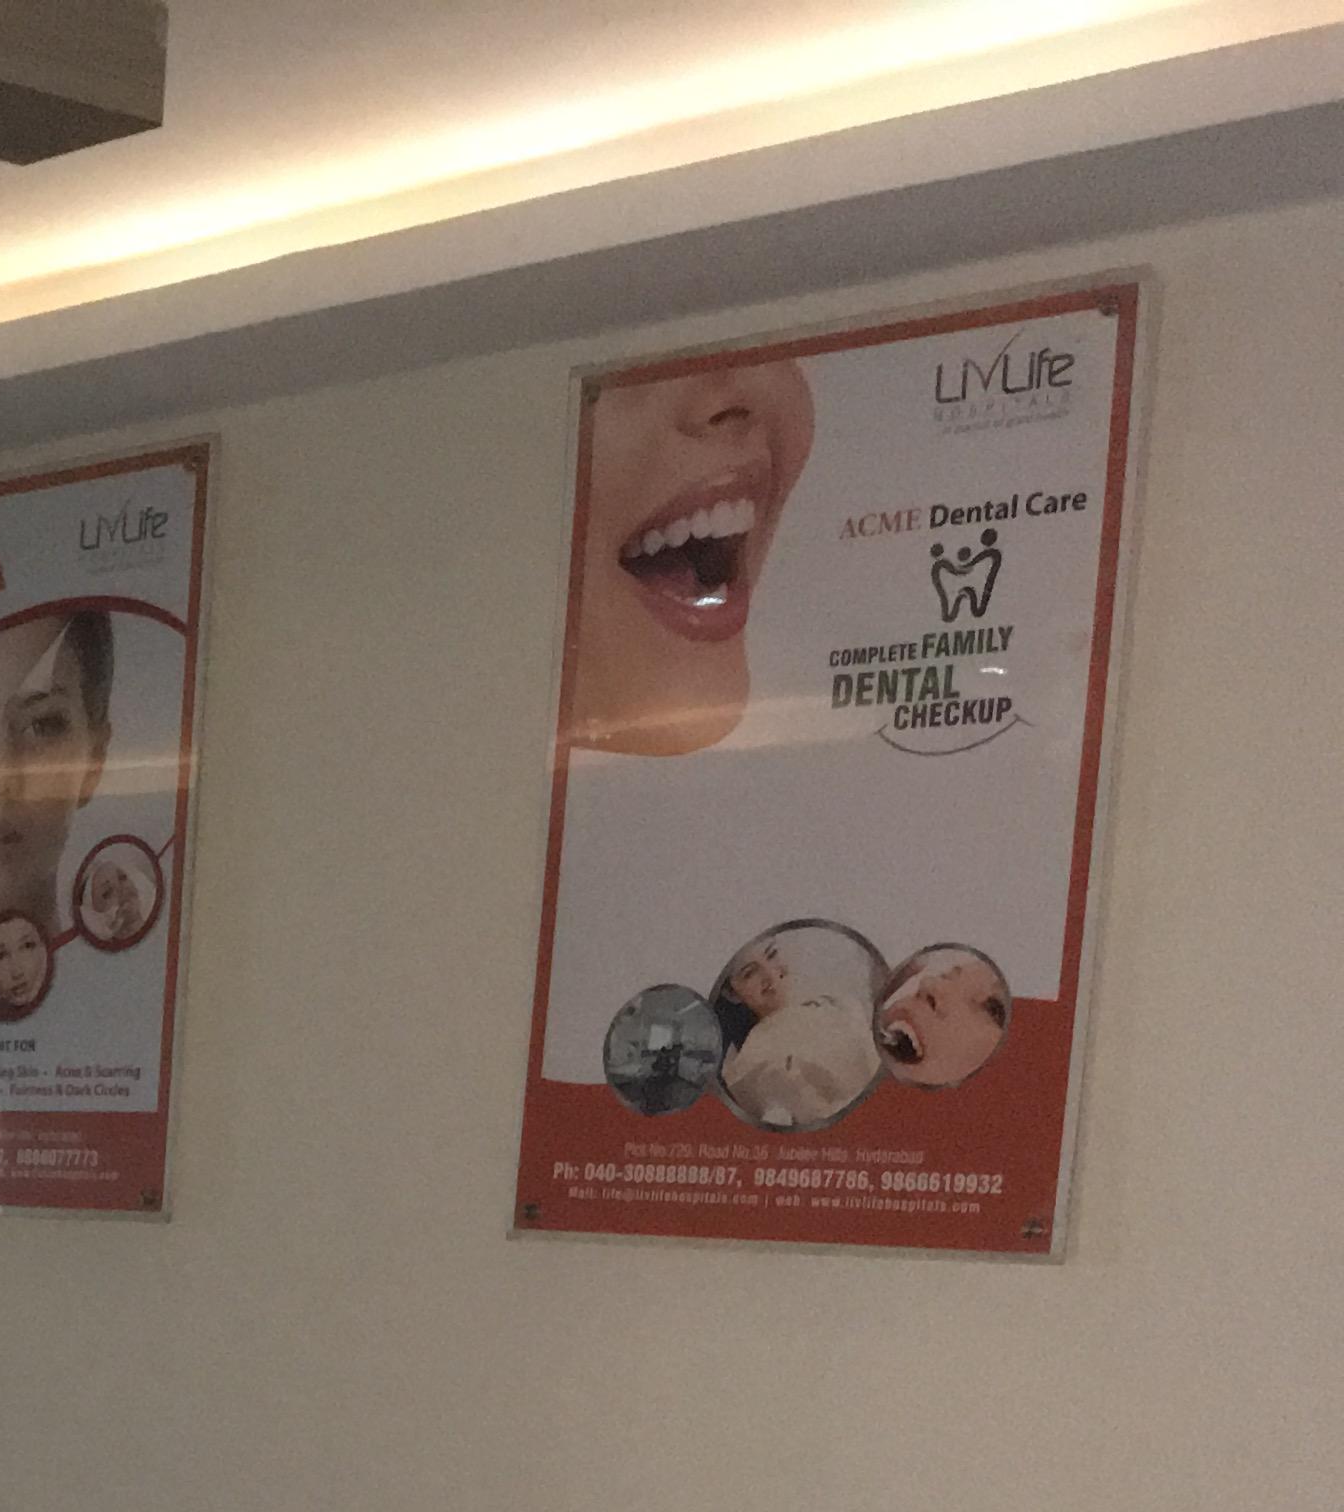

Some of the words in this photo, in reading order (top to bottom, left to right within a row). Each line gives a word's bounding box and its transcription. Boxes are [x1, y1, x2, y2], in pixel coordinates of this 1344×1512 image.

[840, 507, 922, 539] ACME
[929, 493, 1019, 529] Dental
[1025, 491, 1087, 516] Care
[829, 642, 918, 668] COMPLETE
[922, 625, 1014, 660] FAMILY
[831, 664, 960, 710] DENTAL
[893, 696, 1013, 731] CHECKUP
[14, 1039, 36, 1053] FOR
[553, 1161, 579, 1181] Ph:
[698, 1142, 730, 1160] Road
[855, 1147, 926, 1165] Hyderabad
